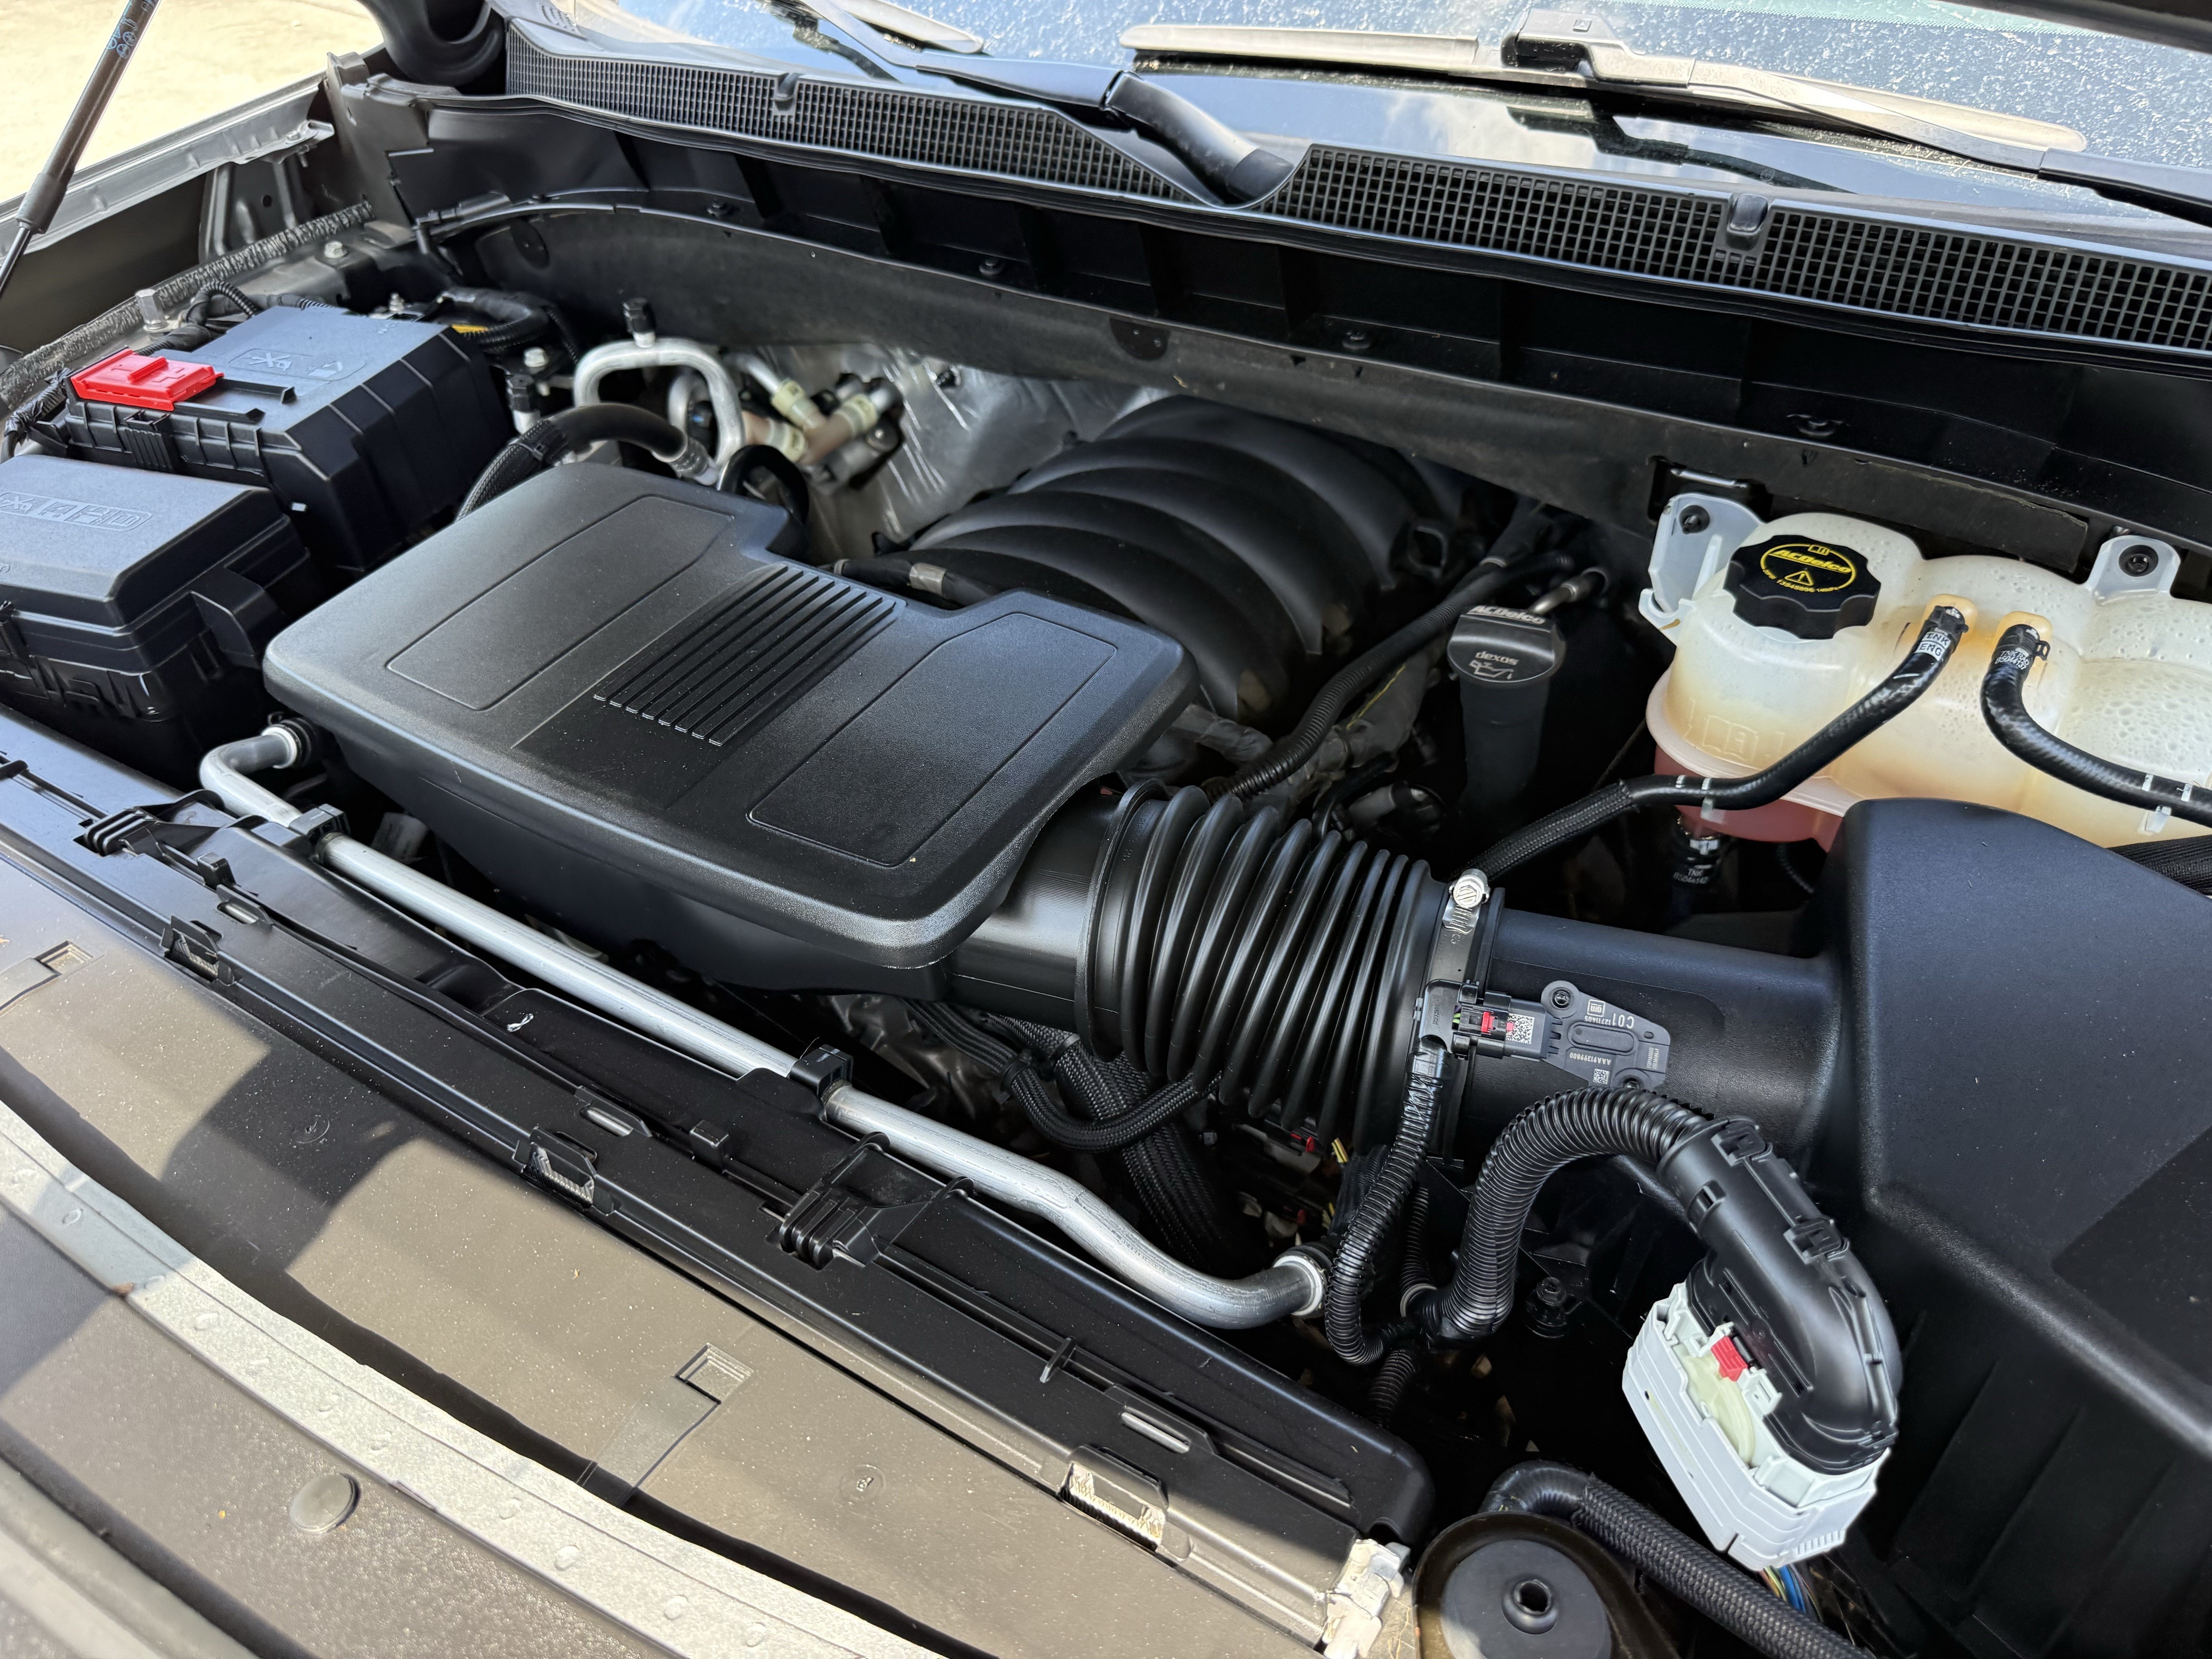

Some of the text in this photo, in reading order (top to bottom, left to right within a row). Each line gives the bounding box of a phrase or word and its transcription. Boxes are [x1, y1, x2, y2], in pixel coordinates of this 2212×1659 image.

[1771, 550, 1851, 573] ACDelco
[1466, 605, 1546, 624] ACDelco
[1475, 651, 1520, 666] dexos
[1584, 1015, 1611, 1026] 12711405
[1612, 1013, 1635, 1029] C01
